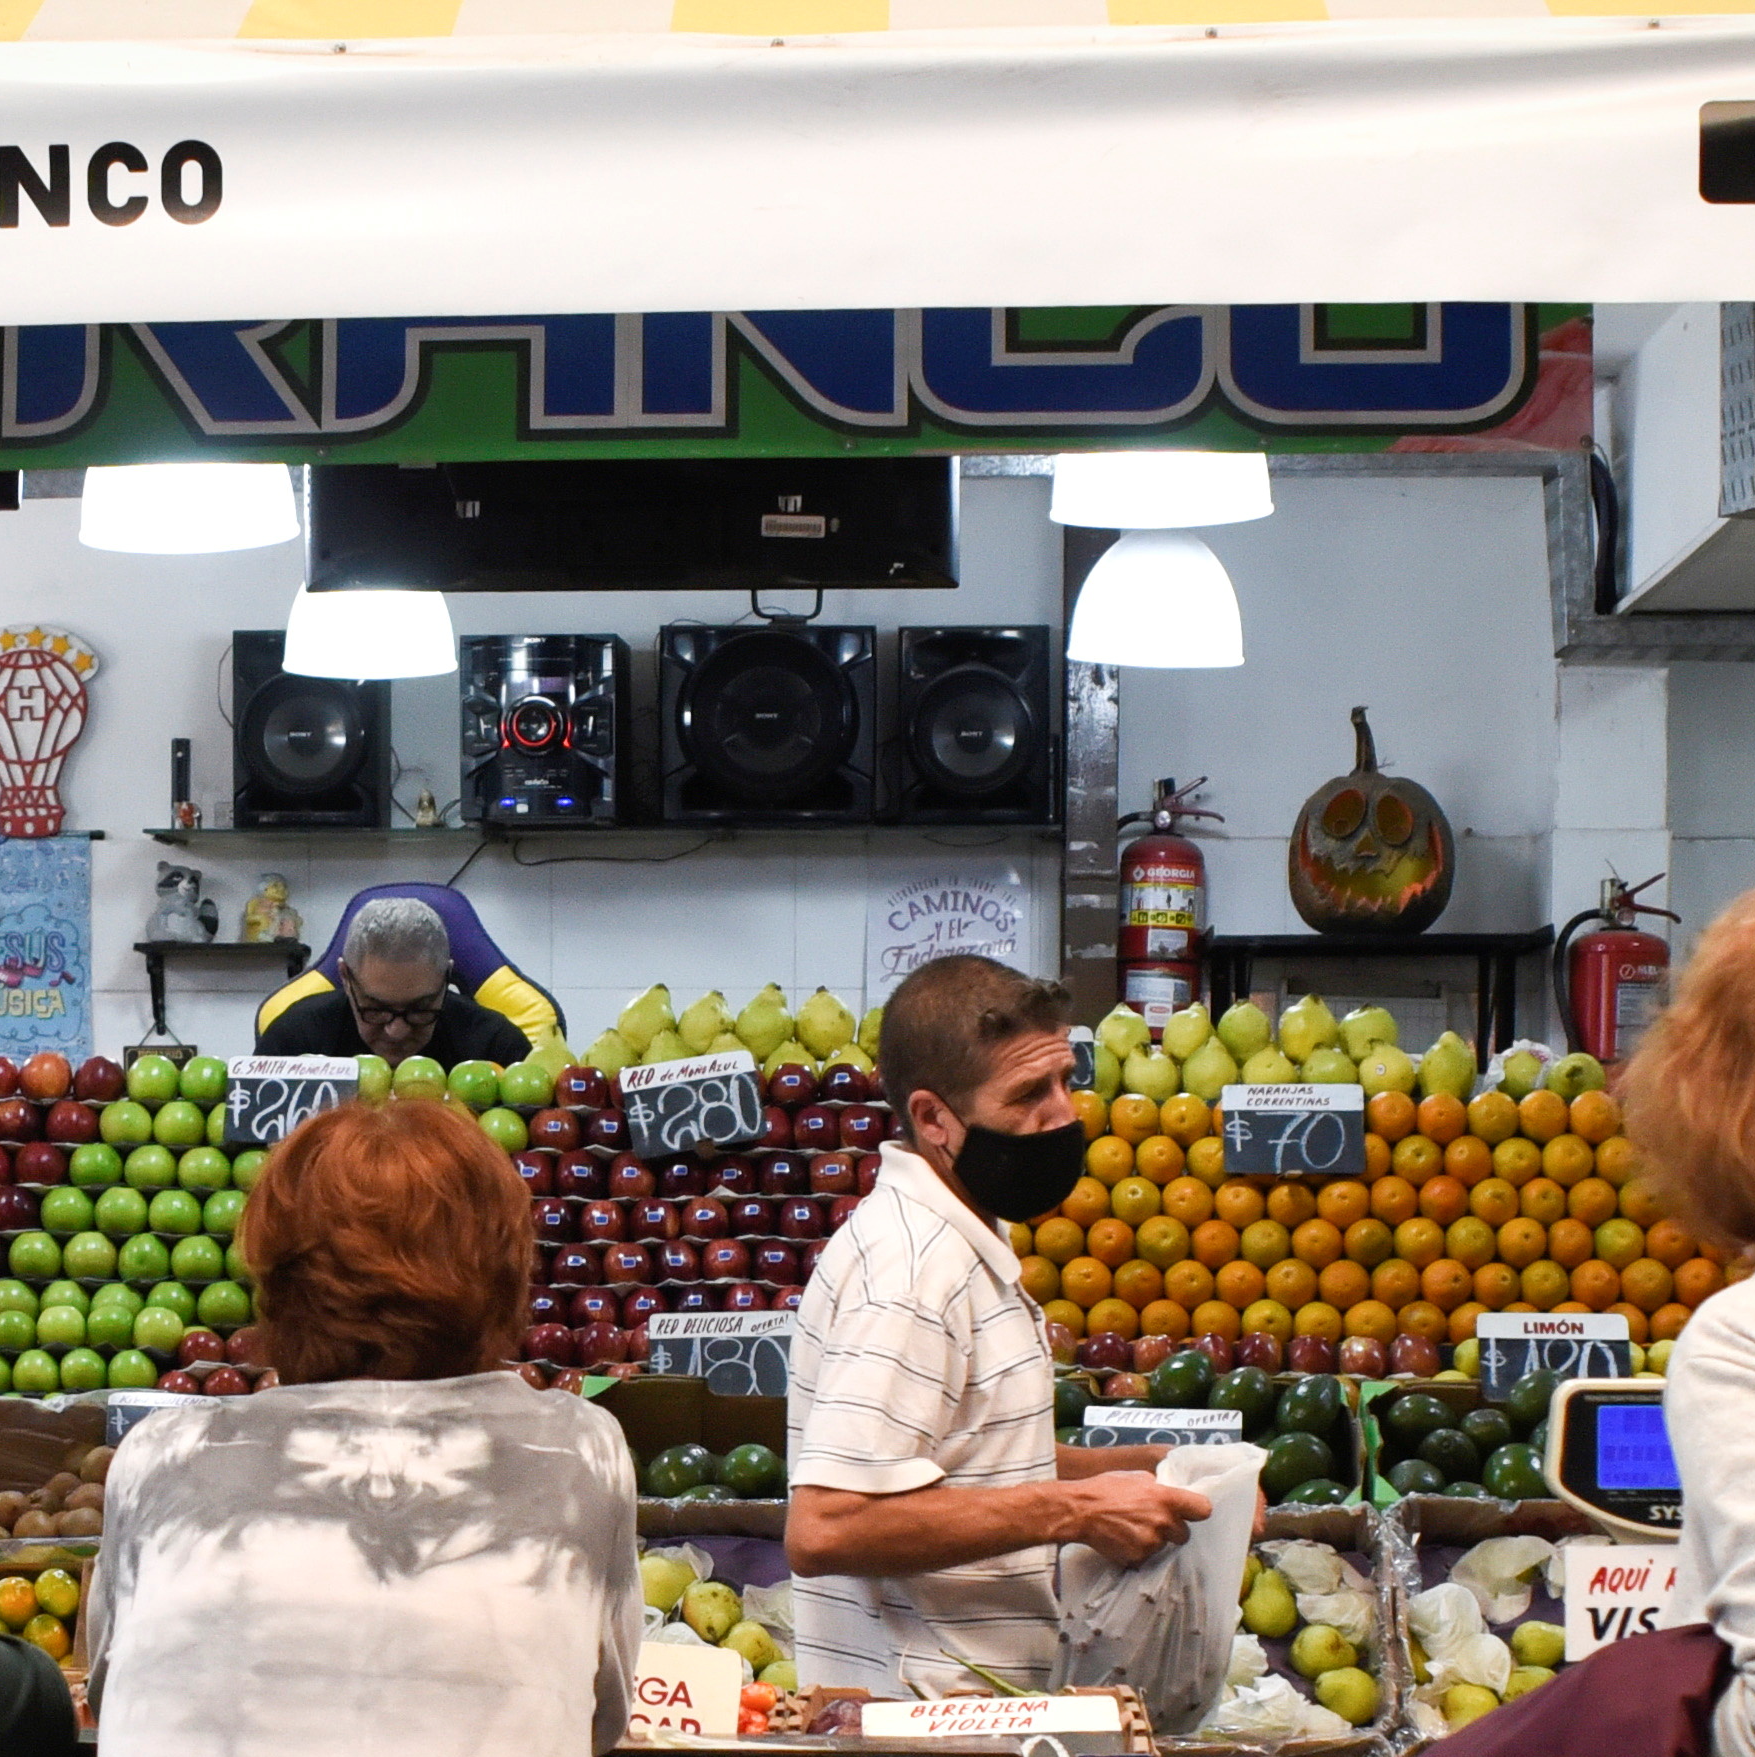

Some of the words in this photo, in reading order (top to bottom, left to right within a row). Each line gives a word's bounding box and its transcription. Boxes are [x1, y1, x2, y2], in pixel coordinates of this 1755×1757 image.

[1146, 867, 1196, 880] GEORGIA
[247, 1059, 286, 1074] SMITH
[626, 1067, 656, 1089] RED
[1247, 1086, 1315, 1096] NARANJAS
[1246, 1096, 1331, 1107] CORRENTINAS
[655, 1317, 680, 1336] RED
[682, 1315, 745, 1335] DELICIOSA
[1523, 1318, 1585, 1336] LIMÓN
[910, 1699, 1052, 1719] BERENJENA
[928, 1716, 1034, 1734] VIOLETA
